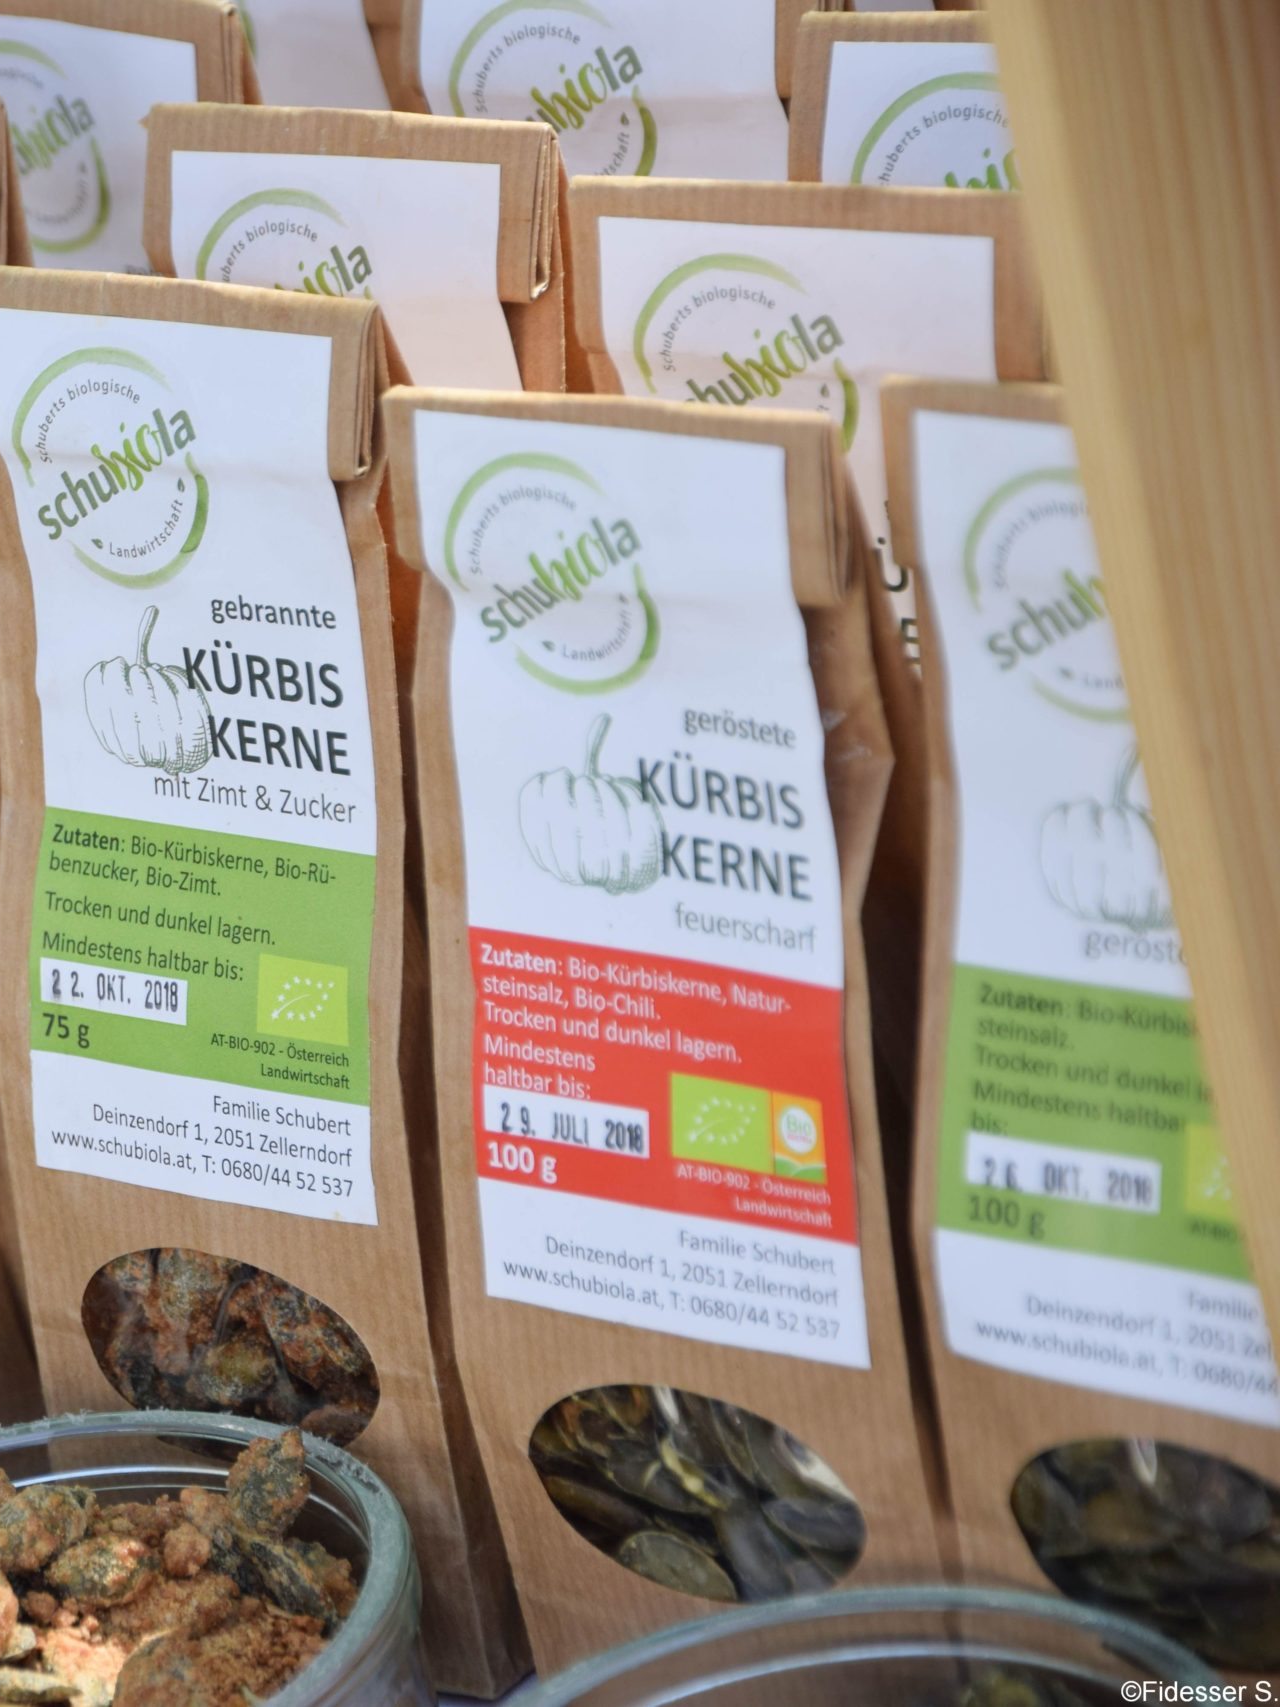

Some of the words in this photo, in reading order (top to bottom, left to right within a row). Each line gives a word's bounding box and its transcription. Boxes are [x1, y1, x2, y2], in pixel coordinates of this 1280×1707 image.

[476, 45, 503, 114] schuberts
[504, 24, 582, 47] biologische
[526, 45, 643, 133] biola
[878, 126, 921, 186] huberts
[221, 240, 245, 282] uberts
[245, 219, 319, 243] biologische
[660, 304, 692, 372] schuberts
[693, 286, 776, 311] biologische
[685, 312, 845, 407] hubiola
[34, 397, 66, 464] schuberts
[67, 378, 141, 405] biologische
[38, 407, 197, 540] schubiola
[499, 486, 577, 511] biologische
[109, 499, 185, 559] Landwirtschaft
[481, 516, 642, 644] schubiola
[211, 595, 337, 629] gebrannte
[182, 639, 344, 708] KÜRBIS
[208, 715, 351, 776] KERNE
[684, 708, 797, 748] geröstete
[155, 775, 191, 800] mit
[198, 777, 248, 808] Zimt
[255, 785, 273, 812] &
[280, 789, 357, 824] Zucker
[638, 752, 804, 830] KÜRBIS
[49, 851, 140, 887] benzucker,
[146, 866, 221, 896] Bio-Zimt.
[52, 824, 125, 852] Zutaten:
[131, 835, 268, 879] Bio-Kürbiskerne,
[275, 857, 337, 885] Bio-Rü-
[661, 832, 813, 901] KERNE
[45, 891, 112, 920] Trocken
[118, 904, 150, 925] und
[155, 907, 212, 935] dunkel
[218, 917, 276, 946] lagern.
[675, 902, 817, 952] feuerscharf
[42, 931, 142, 965] Mindestens
[147, 946, 209, 975] haltbar
[214, 958, 244, 981] bis:
[481, 944, 563, 975] Zutaten:
[569, 956, 727, 1006] Bio-Kürbiskerne,
[732, 984, 791, 1014] Natur-
[97, 972, 132, 1005] OKT.
[144, 980, 179, 1013] 2018
[483, 976, 569, 1009] steinsalz,
[575, 988, 661, 1020] Bio-Chili.
[42, 1013, 70, 1039] 75
[77, 1024, 91, 1049] g
[211, 1033, 276, 1057] AT-BIO-902
[287, 1042, 349, 1068] Österreich
[484, 1001, 556, 1031] Trocken
[562, 1015, 599, 1039] und
[606, 1019, 671, 1051] dunkel
[677, 1034, 742, 1063] lagern.
[485, 1034, 595, 1072] Mindestens
[261, 1064, 350, 1090] Landwirtschaft
[484, 1063, 552, 1092] haltbar
[558, 1075, 591, 1099] bis:
[975, 1044, 1058, 1078] Trocken
[1066, 1063, 1109, 1087] und
[1116, 1068, 1191, 1098] dunkel
[213, 1095, 270, 1123] Familie
[276, 1106, 351, 1137] Schubert
[973, 1078, 1101, 1120] Mindestens
[93, 1104, 189, 1139] Deinzendorf
[194, 1124, 209, 1145] 1,
[214, 1126, 255, 1151] 2051
[259, 1133, 352, 1167] Zellerndorf
[551, 1111, 589, 1145] JULI
[605, 1118, 644, 1153] 2018
[51, 1130, 197, 1173] www.schubiola.at,
[202, 1155, 216, 1174] T:
[222, 1158, 290, 1187] 0680/44
[296, 1172, 317, 1193] 52
[322, 1175, 353, 1198] 537
[487, 1142, 534, 1173] 100
[542, 1155, 557, 1184] g
[677, 1164, 750, 1190] AT-BIO-902
[762, 1177, 831, 1205] Österreich
[736, 1197, 832, 1226] Landwirtschaft
[968, 1196, 1020, 1227] 100
[1029, 1211, 1045, 1240] g
[545, 1235, 654, 1274] Deinzendorf
[660, 1258, 676, 1282] 1,
[681, 1263, 727, 1288] 2051
[733, 1271, 838, 1308] Zellerndorf
[680, 1230, 747, 1259] Familie
[752, 1242, 836, 1276] Schubert
[503, 1261, 664, 1311] www.schubiola.at,
[669, 1292, 686, 1312] T:
[691, 1295, 769, 1328] 0680/44
[776, 1311, 799, 1332] 52
[806, 1316, 840, 1341] 537
